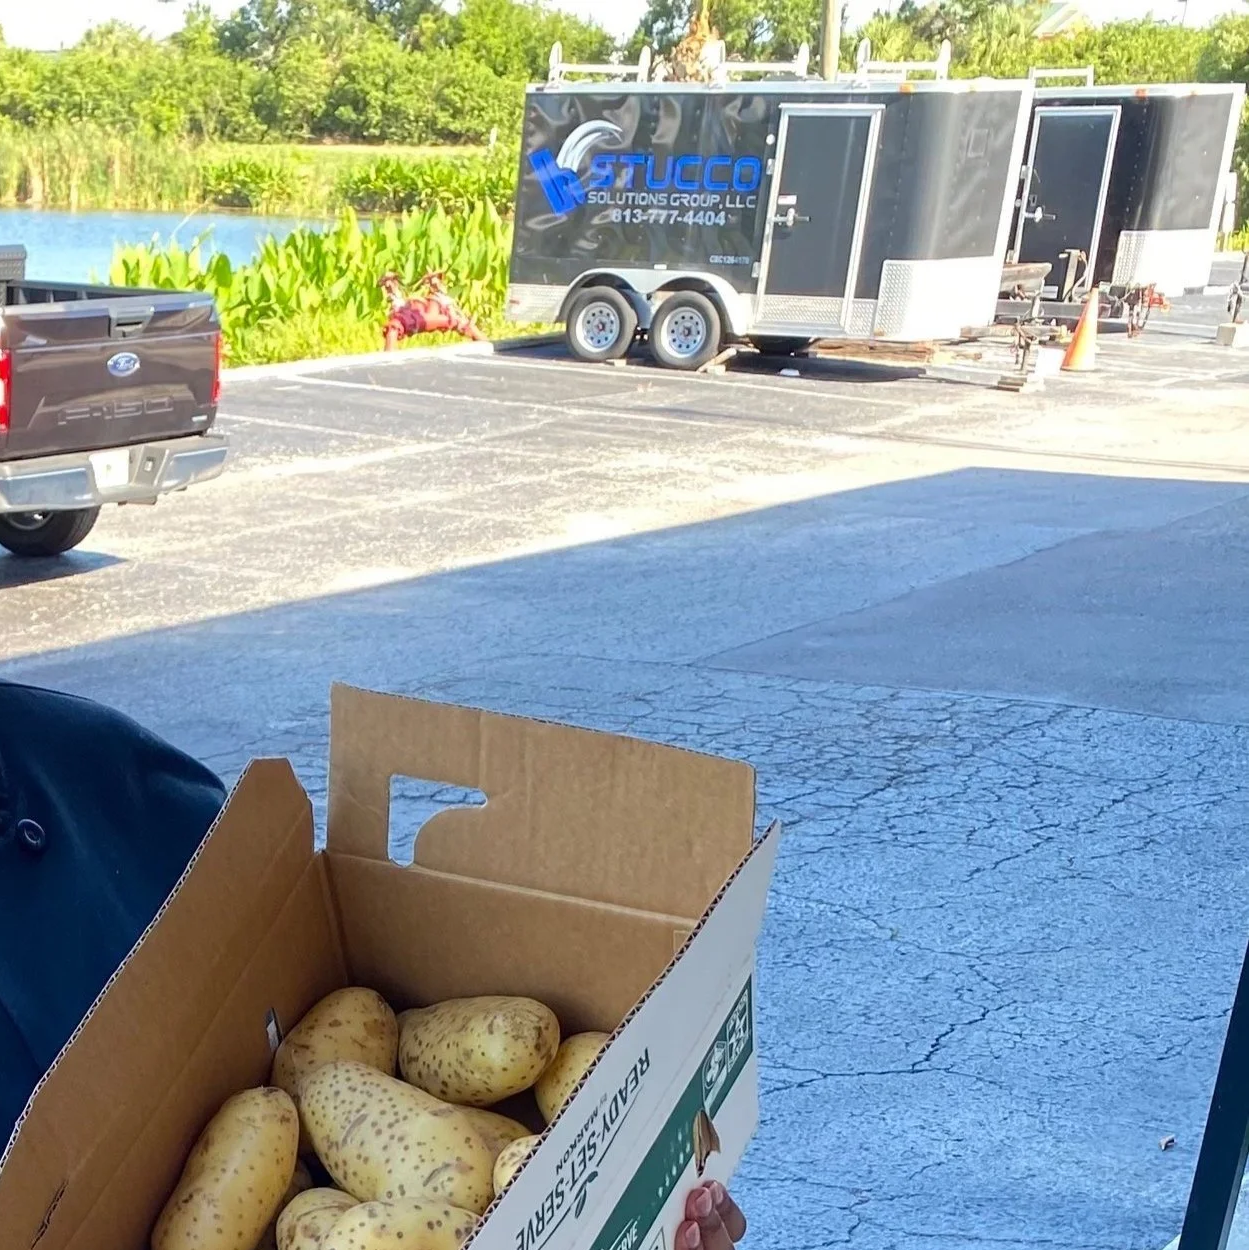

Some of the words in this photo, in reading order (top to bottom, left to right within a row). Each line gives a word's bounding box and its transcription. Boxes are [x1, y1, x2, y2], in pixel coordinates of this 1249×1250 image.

[590, 154, 762, 191] STUCCO
[588, 192, 667, 205] SOLUTIONS
[670, 194, 723, 209] GROUP,
[726, 196, 756, 208] LLC
[612, 209, 726, 226] 813-777-4404
[555, 1106, 599, 1176] MARKON
